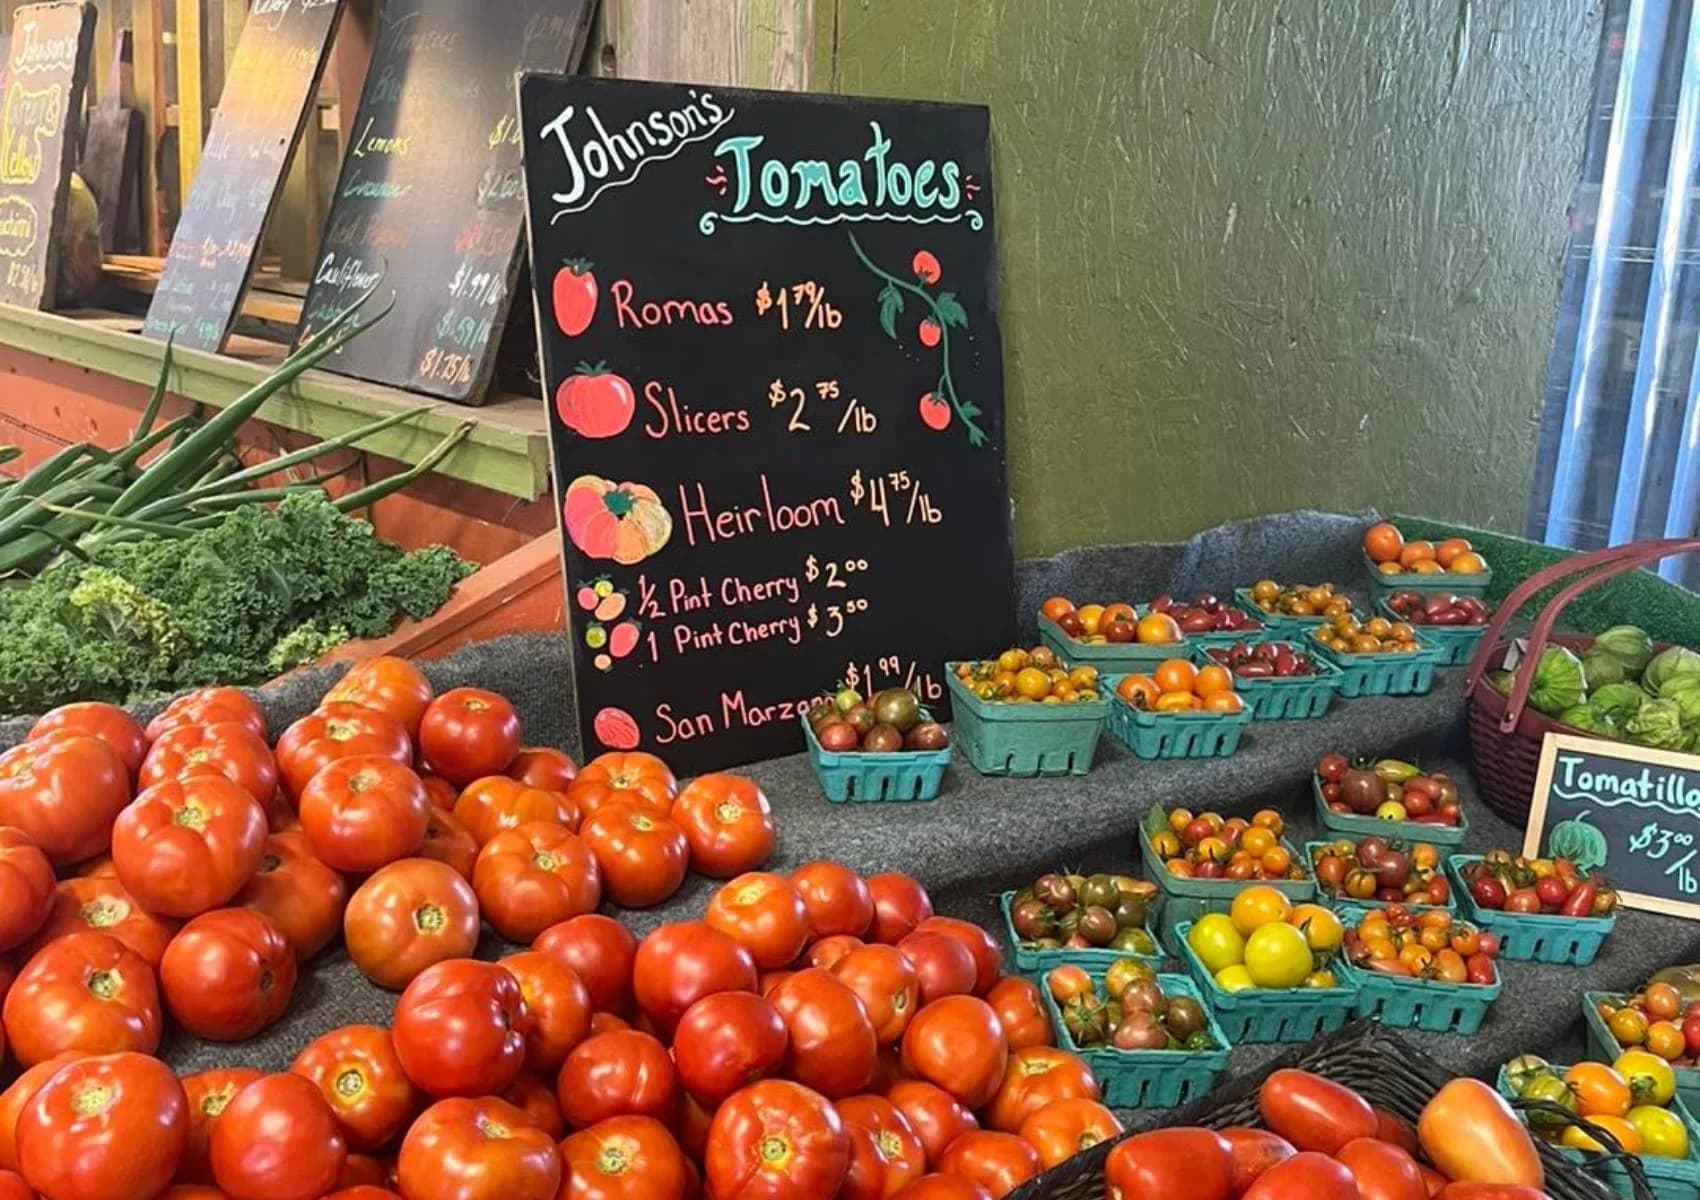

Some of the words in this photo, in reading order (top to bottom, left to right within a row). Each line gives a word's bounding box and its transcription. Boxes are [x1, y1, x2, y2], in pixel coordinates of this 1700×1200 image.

[540, 89, 723, 203] Johnson's
[714, 121, 960, 213] Tomatoes
[610, 279, 733, 328] Romas
[644, 381, 750, 438] Slicers
[679, 474, 845, 546] Heirloom
[669, 576, 712, 614] Pint
[721, 577, 800, 605] Cherry
[646, 631, 659, 662] 1
[673, 623, 723, 654] Pint
[728, 616, 801, 645] Cherry
[656, 703, 714, 744] San
